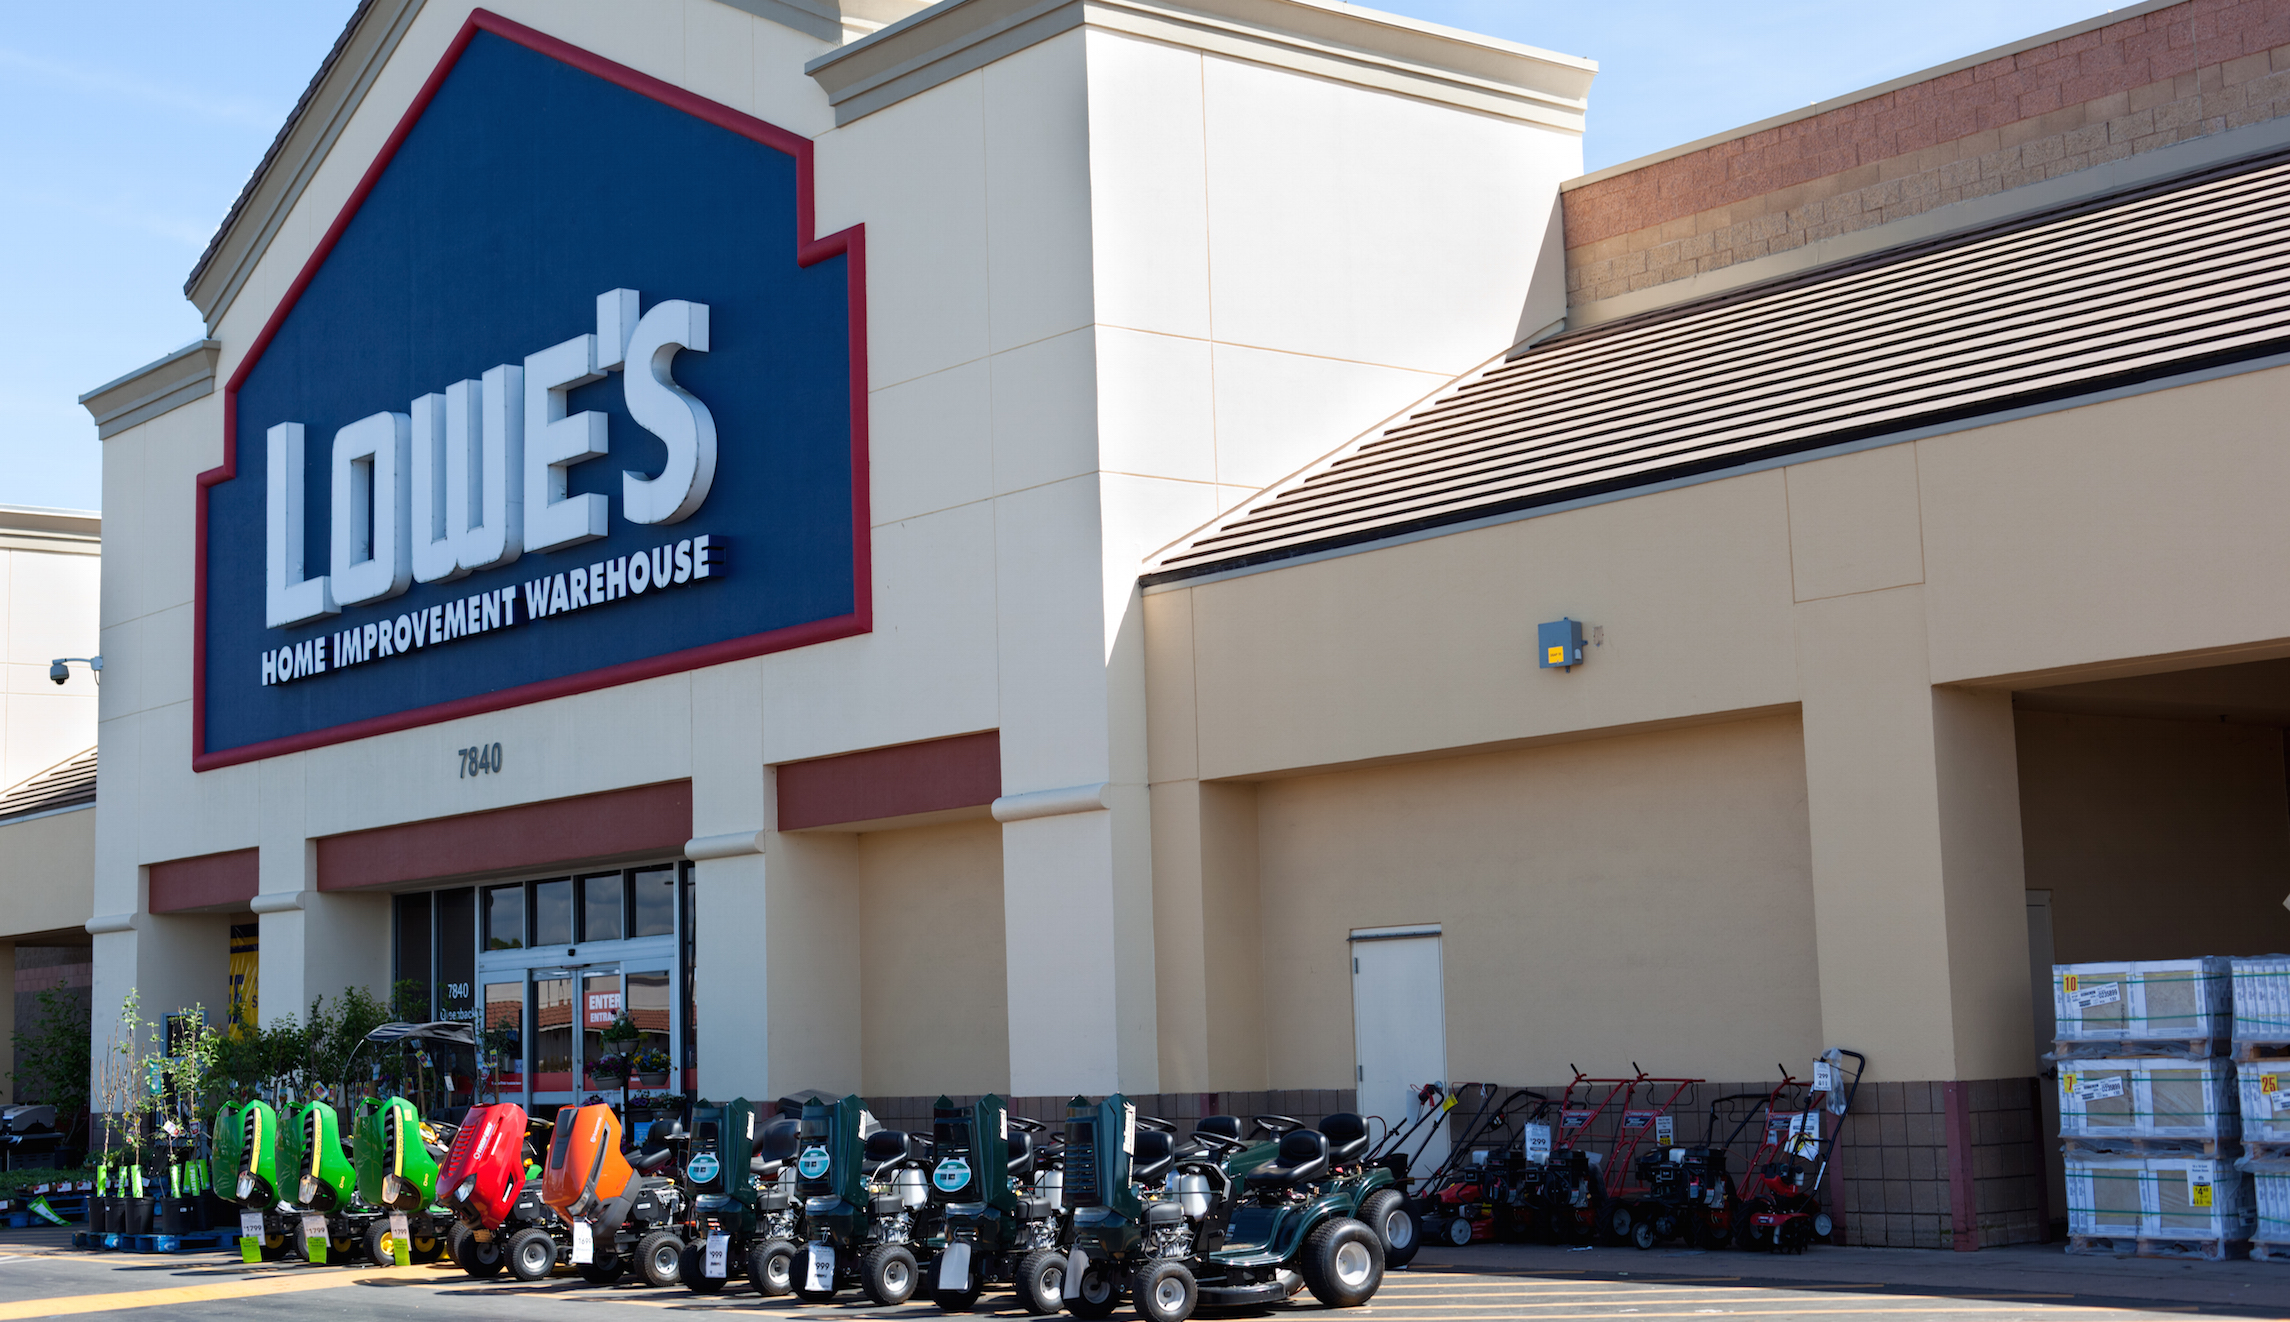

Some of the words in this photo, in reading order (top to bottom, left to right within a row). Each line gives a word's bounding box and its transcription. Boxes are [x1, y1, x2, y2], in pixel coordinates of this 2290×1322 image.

[266, 287, 717, 630] LOWE'S
[261, 636, 327, 687] HOME
[333, 584, 518, 669] IMPROVEMENT
[525, 533, 712, 621] WAREHOUSE
[458, 742, 503, 779] 7840
[447, 982, 469, 999] 7840
[2065, 976, 2077, 992] 10
[2066, 1075, 2073, 1091] 7
[2262, 1076, 2276, 1093] 25
